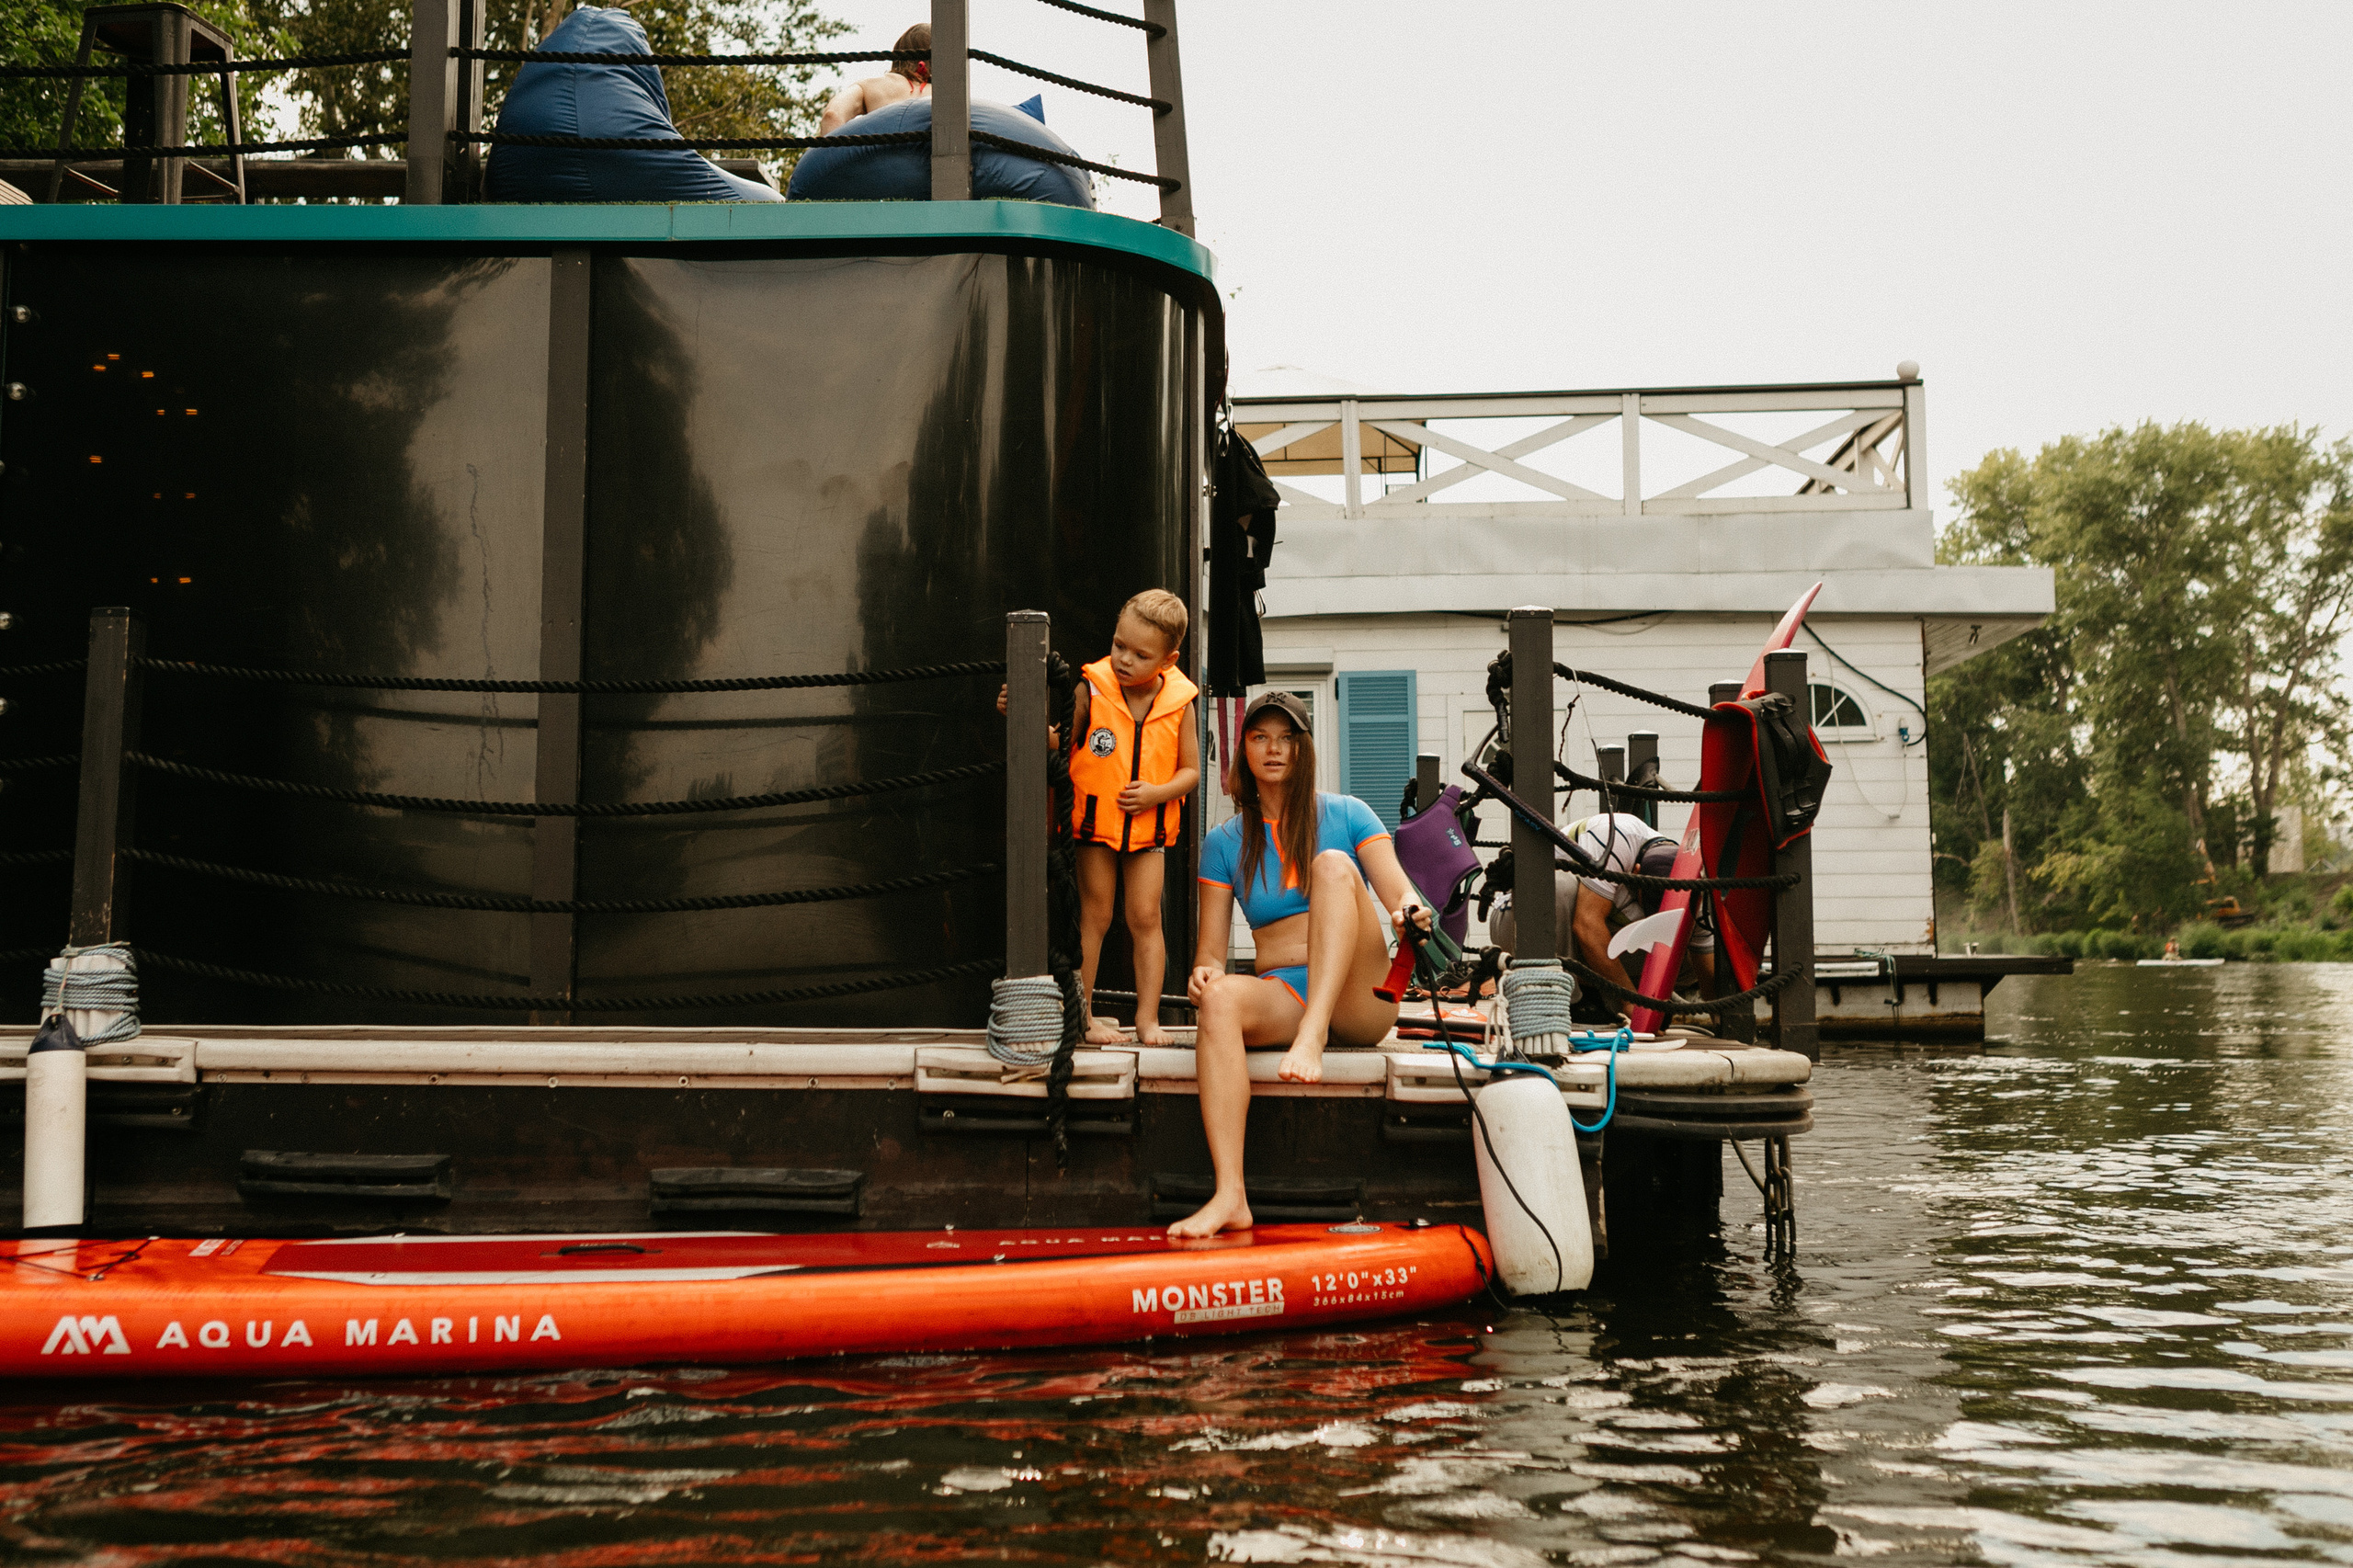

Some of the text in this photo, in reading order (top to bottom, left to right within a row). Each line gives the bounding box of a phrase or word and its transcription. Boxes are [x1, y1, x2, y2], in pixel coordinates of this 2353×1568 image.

[1131, 1277, 1285, 1313] MONSTER
[1204, 1306, 1242, 1320] LIGHT
[1249, 1304, 1281, 1315] TECH
[155, 1319, 313, 1349] AQUA
[345, 1313, 562, 1346] MARINA
